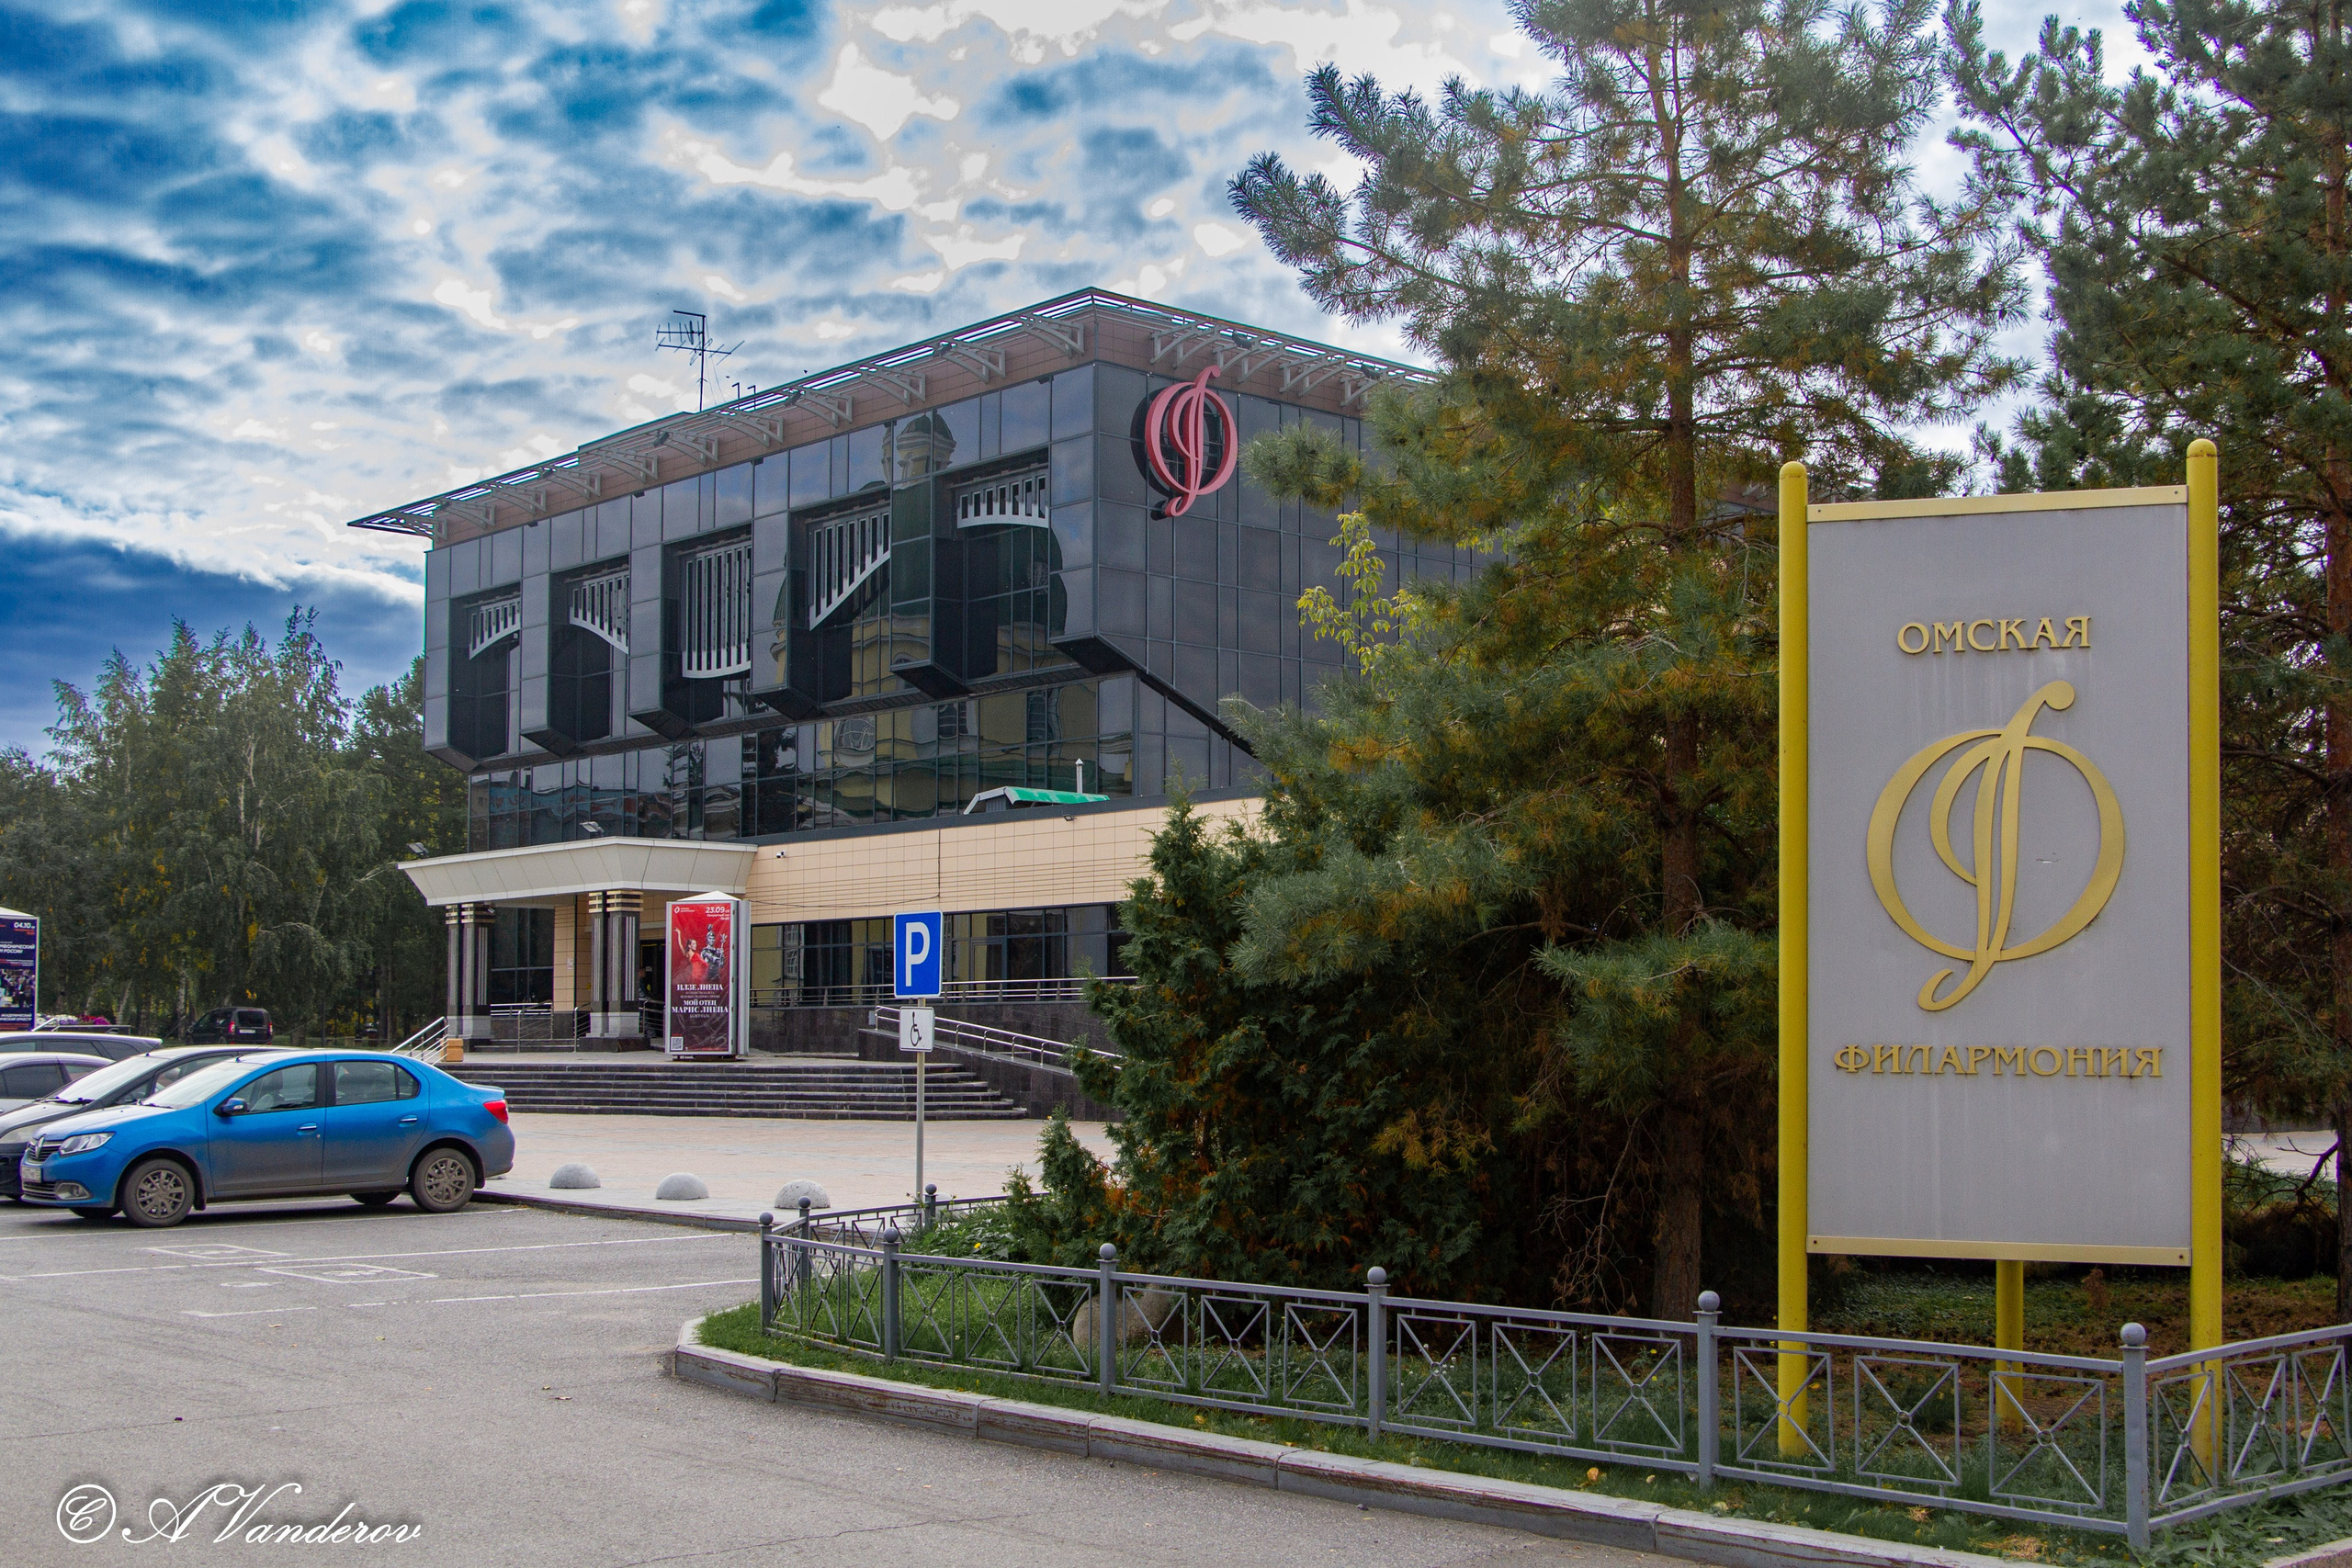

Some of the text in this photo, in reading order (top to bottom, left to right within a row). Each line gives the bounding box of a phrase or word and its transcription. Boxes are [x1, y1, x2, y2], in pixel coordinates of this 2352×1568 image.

[1897, 615, 2091, 654] ОМСКАЯ
[706, 906, 725, 914] 23.09
[905, 921, 931, 987] P
[1833, 1043, 2163, 1077] ФИЛАРМОНИЯ
